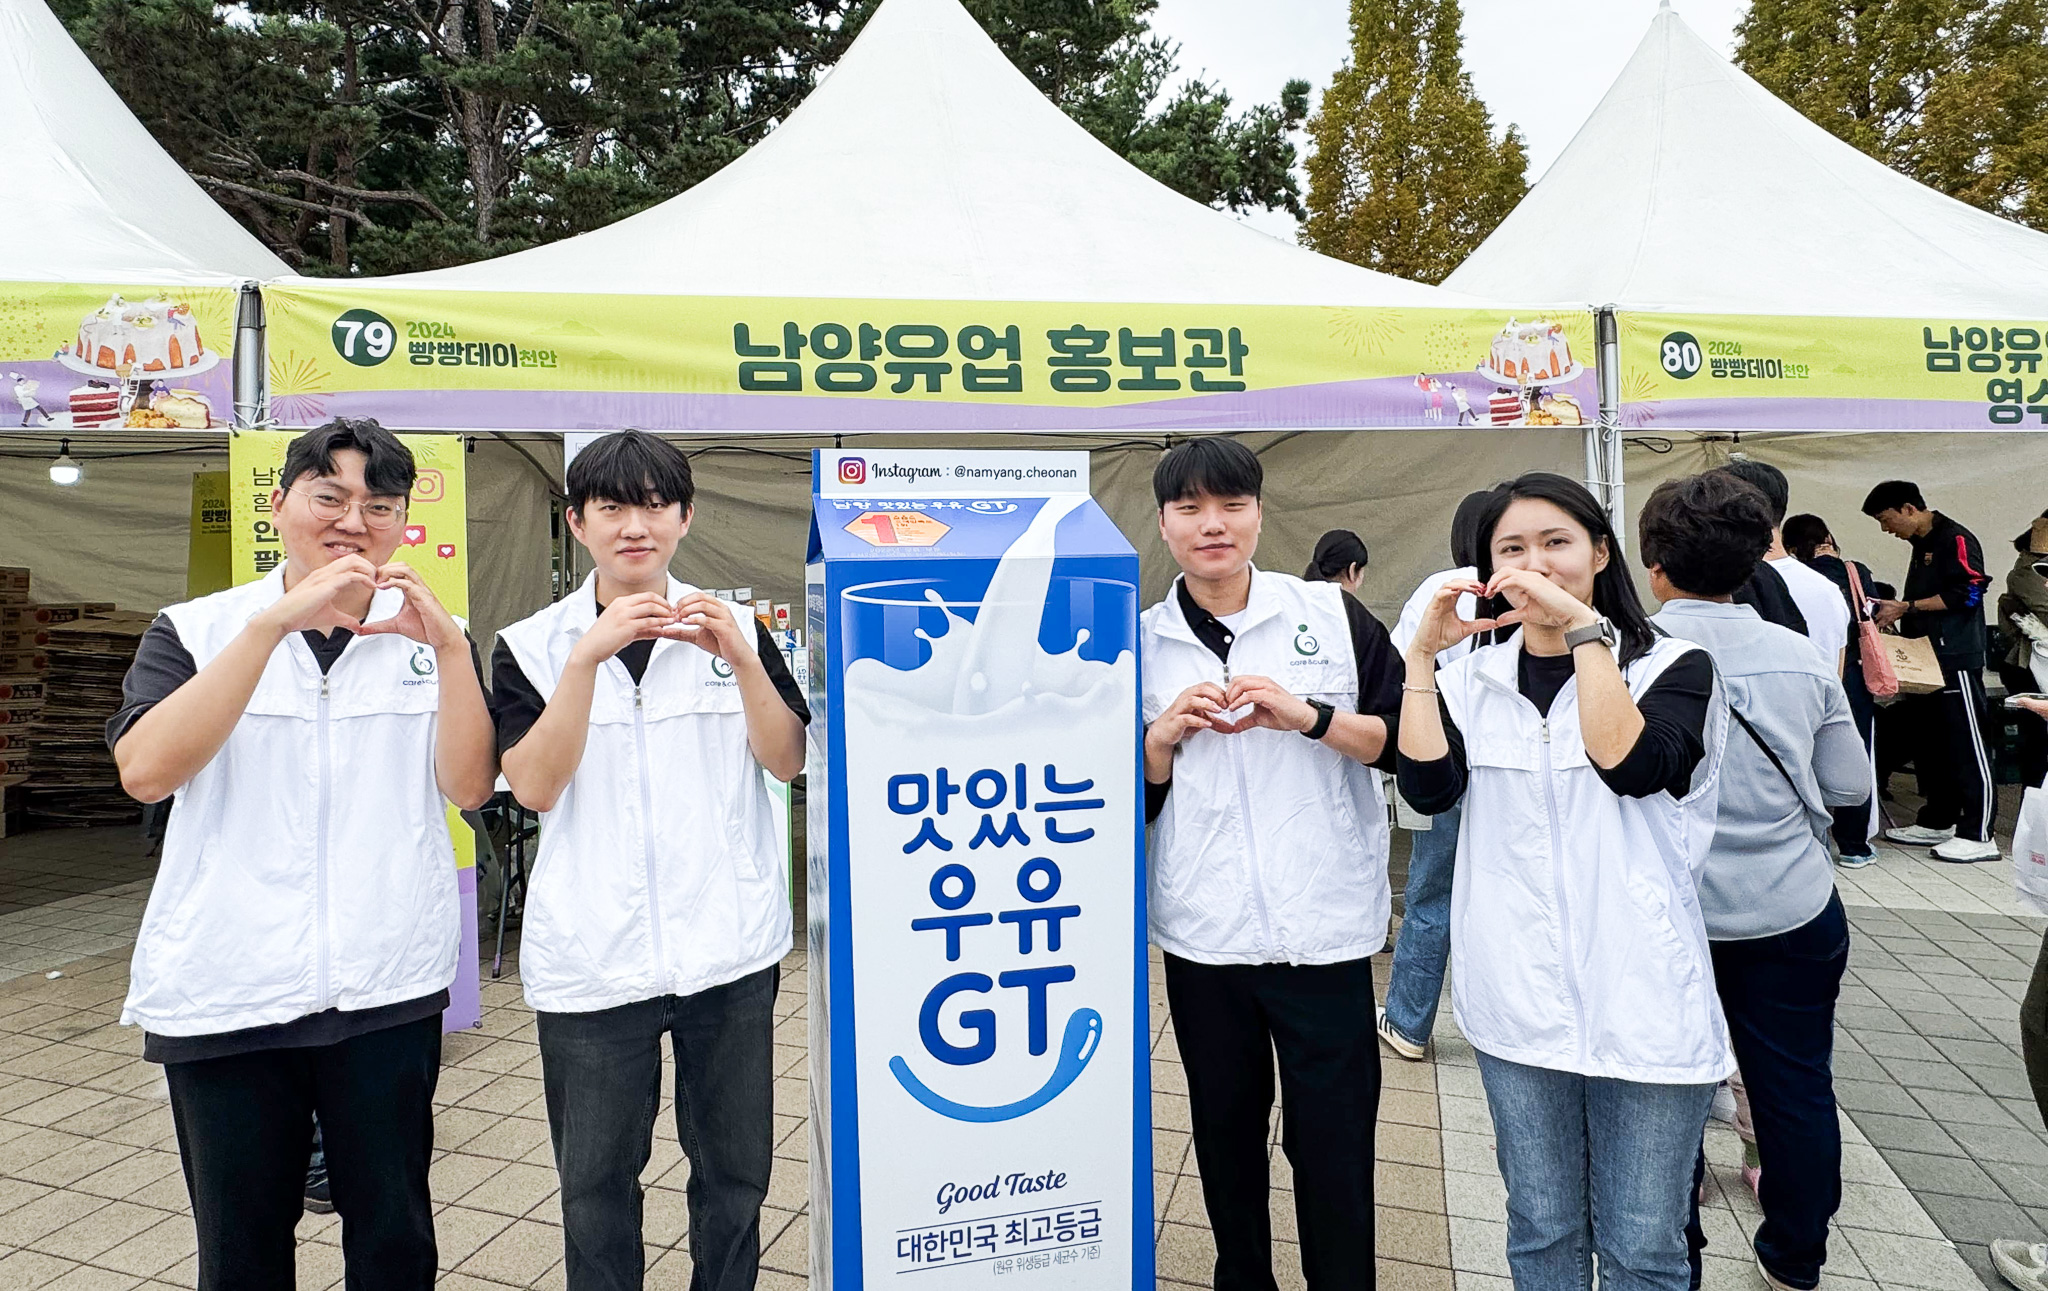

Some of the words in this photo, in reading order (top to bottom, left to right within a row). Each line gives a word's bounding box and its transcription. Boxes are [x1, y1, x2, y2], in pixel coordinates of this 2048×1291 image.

[335, 320, 393, 358] 79
[405, 321, 456, 339] 2024
[733, 321, 1023, 393] 남양유업
[1046, 323, 1250, 393] 홍보관
[1662, 340, 1701, 373] 80
[1708, 340, 1742, 356] 2024
[1923, 325, 2048, 375] 남양유
[871, 462, 942, 484] Instagram
[954, 464, 1077, 481] @namyang.cheonan
[201, 509, 231, 523] 빵빵
[202, 499, 226, 509] 2024
[971, 500, 1008, 511] GT
[861, 514, 899, 544] 1
[886, 762, 1106, 855] 맛있는
[910, 856, 1082, 962] 우유
[918, 963, 1077, 1066] GT
[936, 1174, 1001, 1215] Good
[1004, 1169, 1068, 1197] Taste
[896, 1223, 999, 1263] 대한민국
[1004, 1207, 1102, 1246] 최고등급
[992, 1259, 1014, 1277] (원유
[1016, 1255, 1051, 1272] 위생등급
[1053, 1250, 1079, 1265] 세균수
[1081, 1244, 1101, 1260] 기준)
